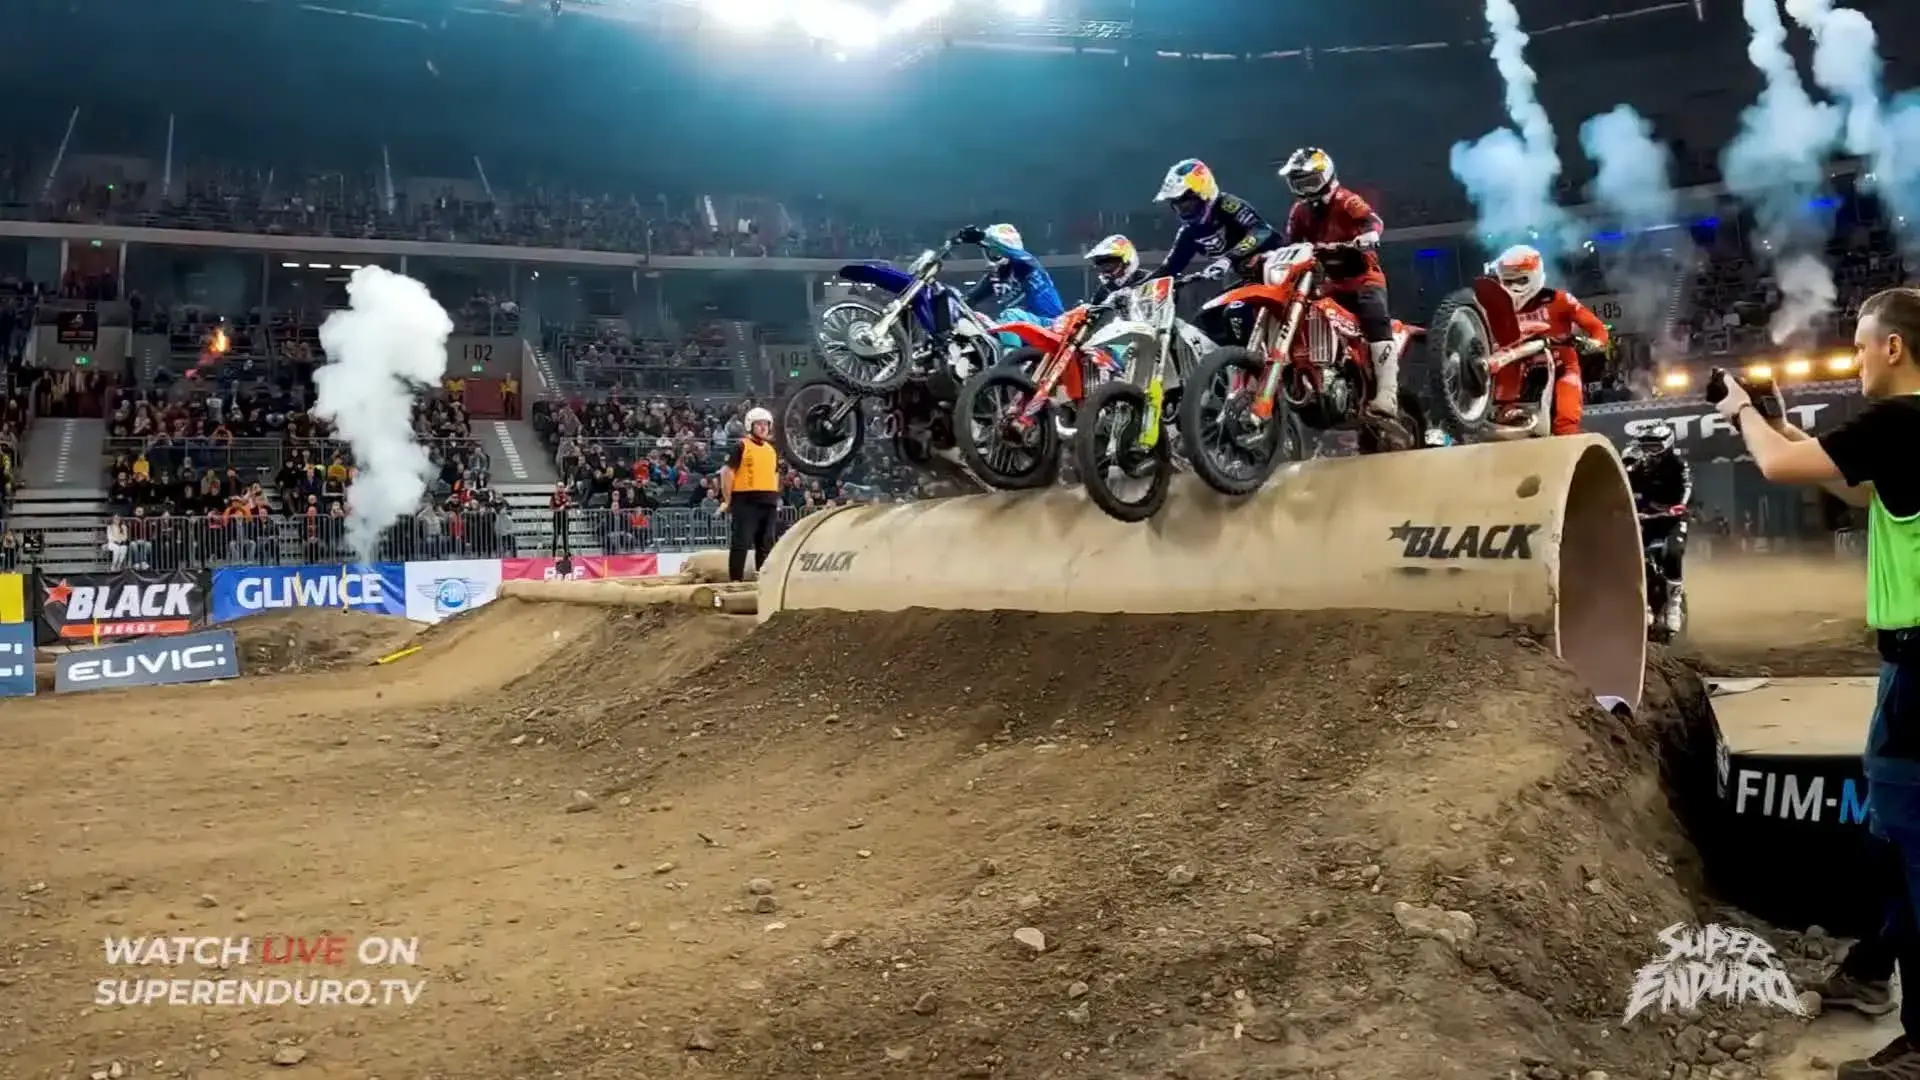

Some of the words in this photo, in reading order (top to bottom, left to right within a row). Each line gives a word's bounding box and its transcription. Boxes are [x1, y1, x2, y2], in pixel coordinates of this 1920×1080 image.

[1623, 402, 1829, 441] STAT
[1402, 523, 1541, 560] BLACK
[800, 550, 859, 573] BLACK
[65, 582, 194, 620] BLACK
[236, 573, 384, 609] GLIWICE
